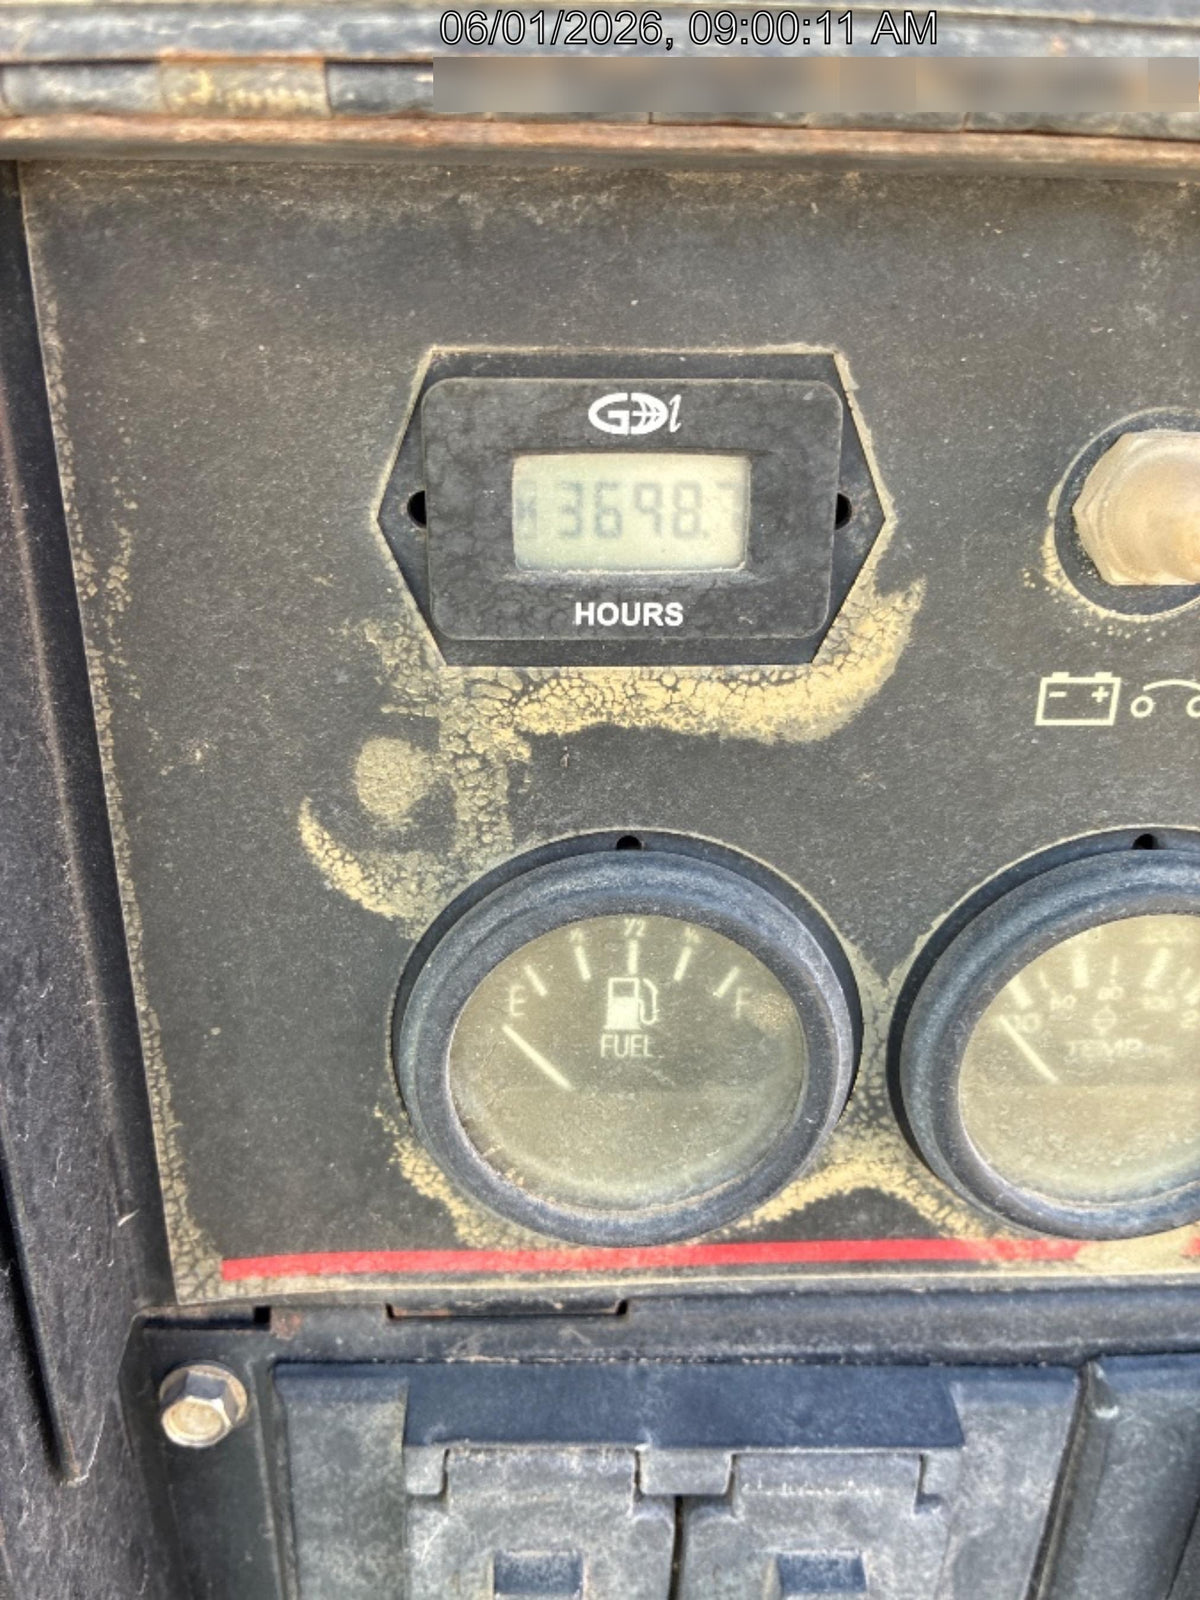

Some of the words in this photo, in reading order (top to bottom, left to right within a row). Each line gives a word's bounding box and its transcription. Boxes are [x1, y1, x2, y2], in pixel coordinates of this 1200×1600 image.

[575, 601, 684, 627] HOURS
[508, 985, 527, 1017] E
[600, 1034, 653, 1058] FUEL
